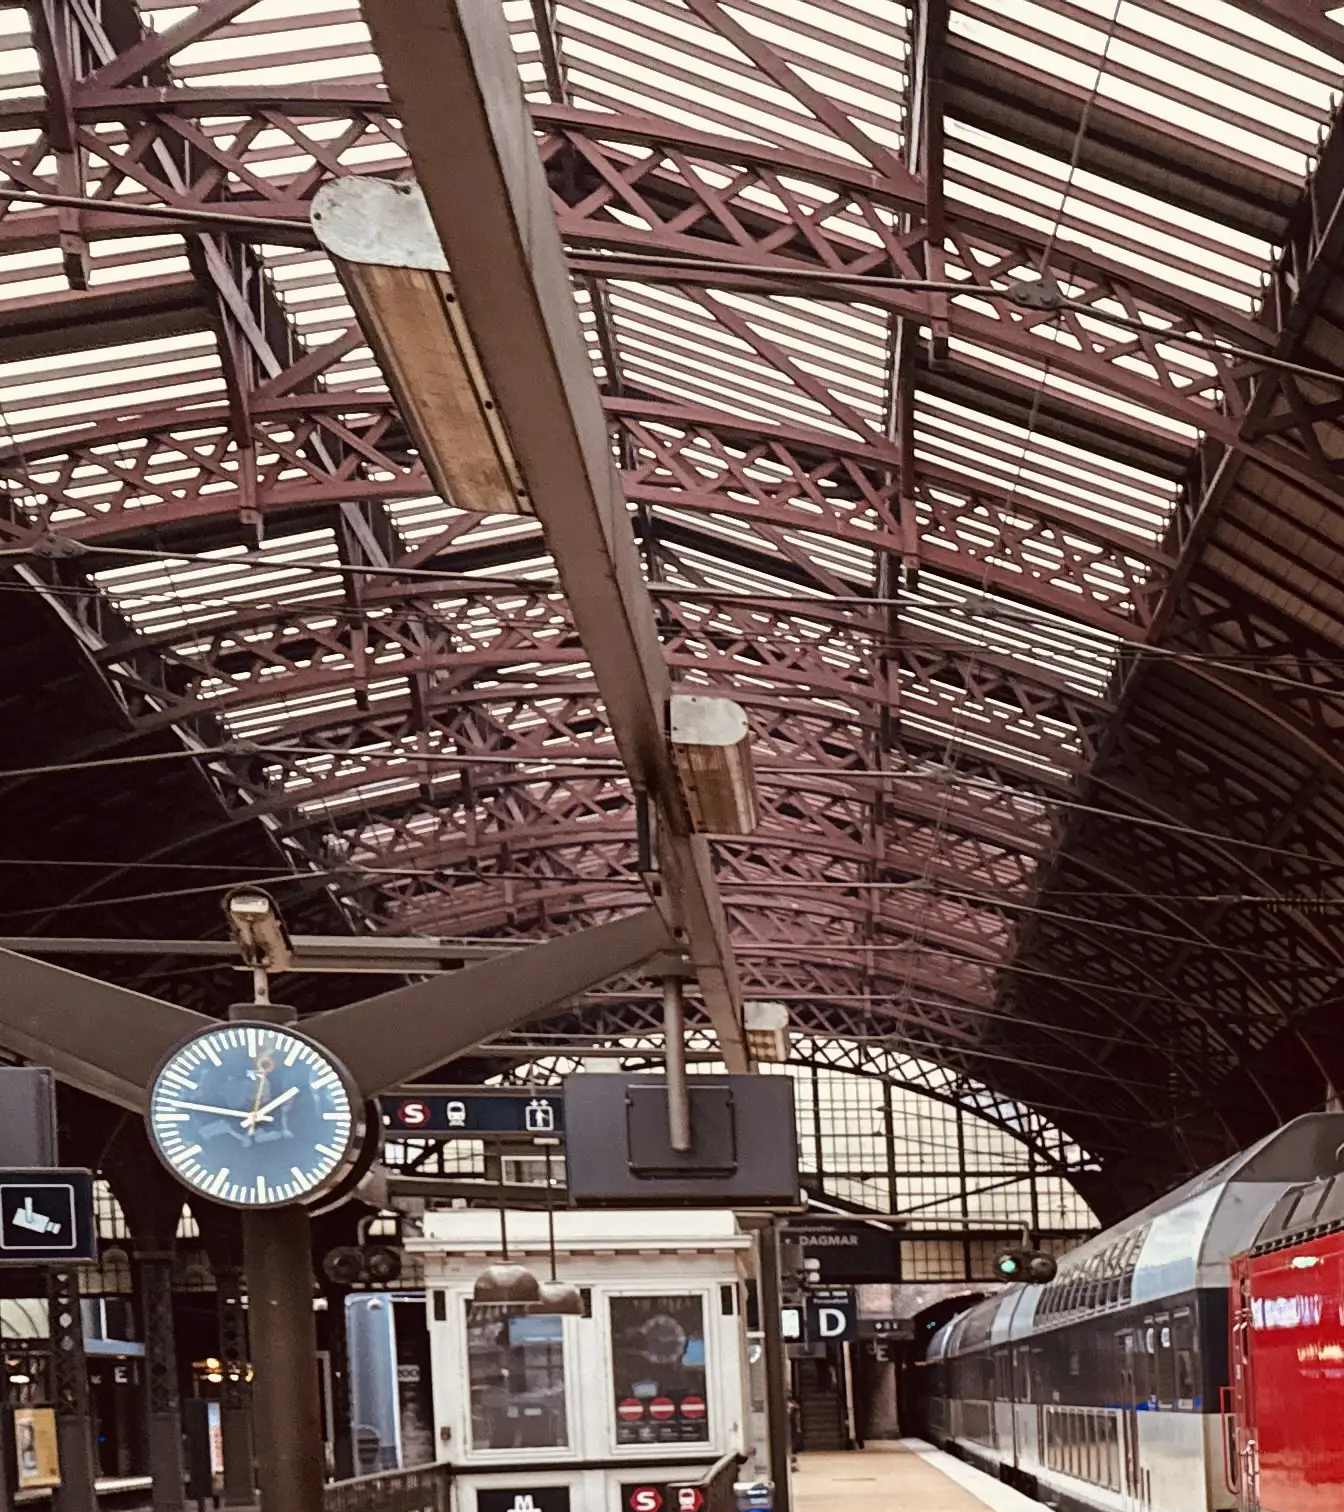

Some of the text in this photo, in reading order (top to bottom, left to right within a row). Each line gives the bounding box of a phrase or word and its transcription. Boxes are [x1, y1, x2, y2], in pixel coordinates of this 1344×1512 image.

[404, 1104, 425, 1123] S
[800, 1235, 858, 1246] DAGMAR
[818, 1308, 846, 1337] D
[114, 1366, 128, 1384] E
[636, 1491, 657, 1511] S
